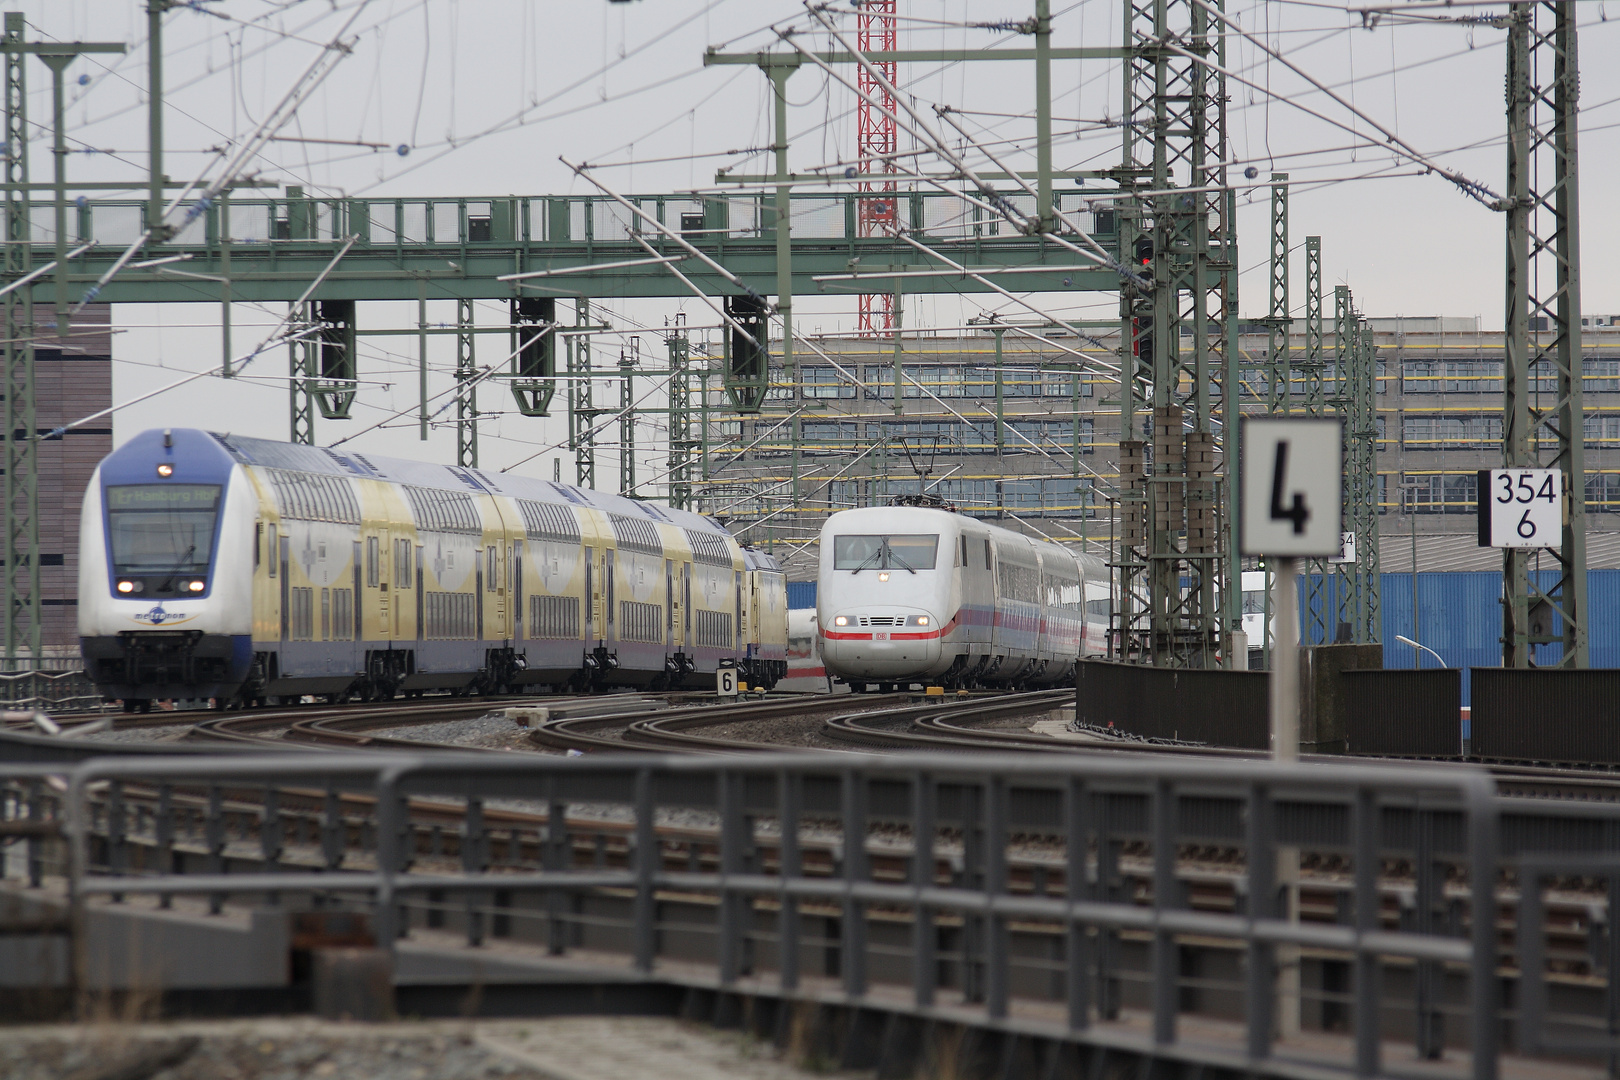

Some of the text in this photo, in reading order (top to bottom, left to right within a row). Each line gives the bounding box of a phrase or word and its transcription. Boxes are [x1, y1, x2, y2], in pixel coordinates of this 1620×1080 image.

[135, 489, 191, 502] Hamburg
[194, 489, 216, 501] Hbf
[1270, 438, 1311, 534] 4
[1497, 474, 1557, 504] 354
[1517, 509, 1537, 539] 6
[1340, 533, 1354, 545] 54
[134, 611, 186, 620] metronom
[722, 672, 732, 692] 6
